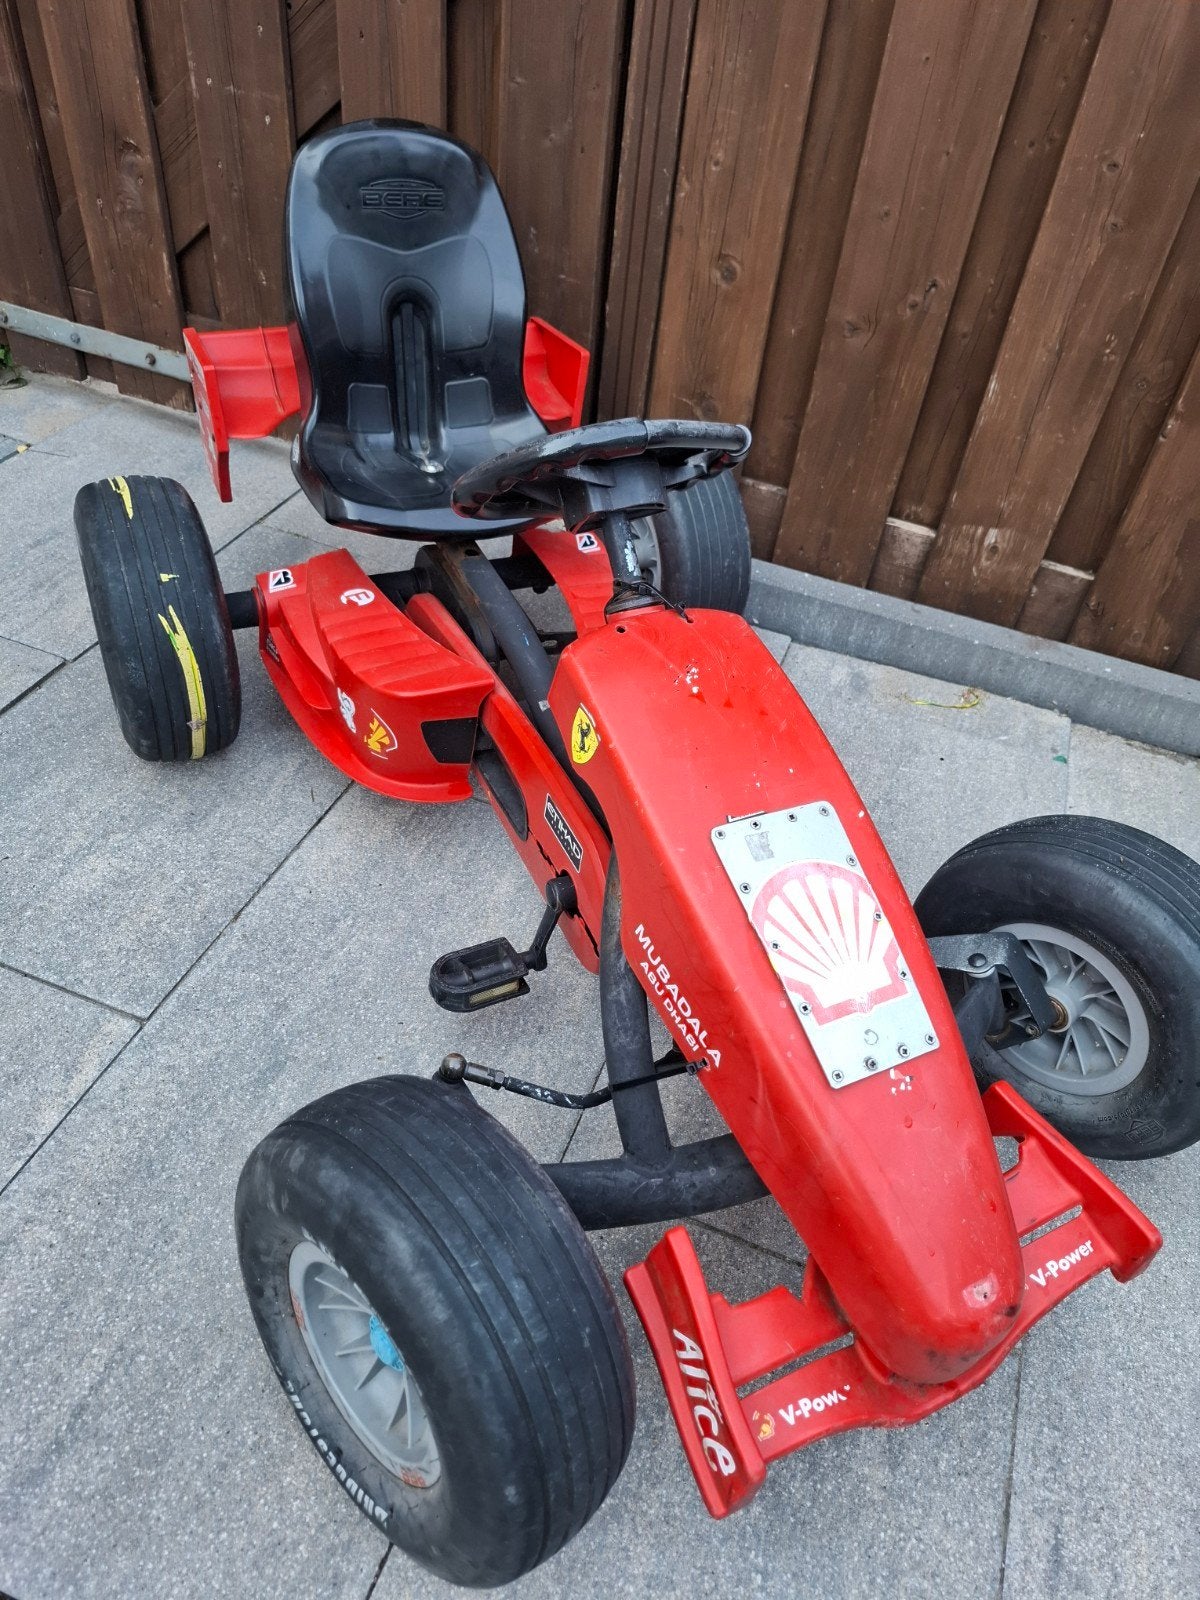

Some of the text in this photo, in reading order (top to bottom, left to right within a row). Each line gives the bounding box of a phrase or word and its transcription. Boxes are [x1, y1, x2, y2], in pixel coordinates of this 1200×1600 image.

[546, 802, 582, 859] ETIHAD
[634, 924, 721, 1068] MUBADALA
[640, 961, 700, 1052] ABU DHABI
[1029, 1239, 1094, 1287] V-Power
[672, 1328, 736, 1477] Alice
